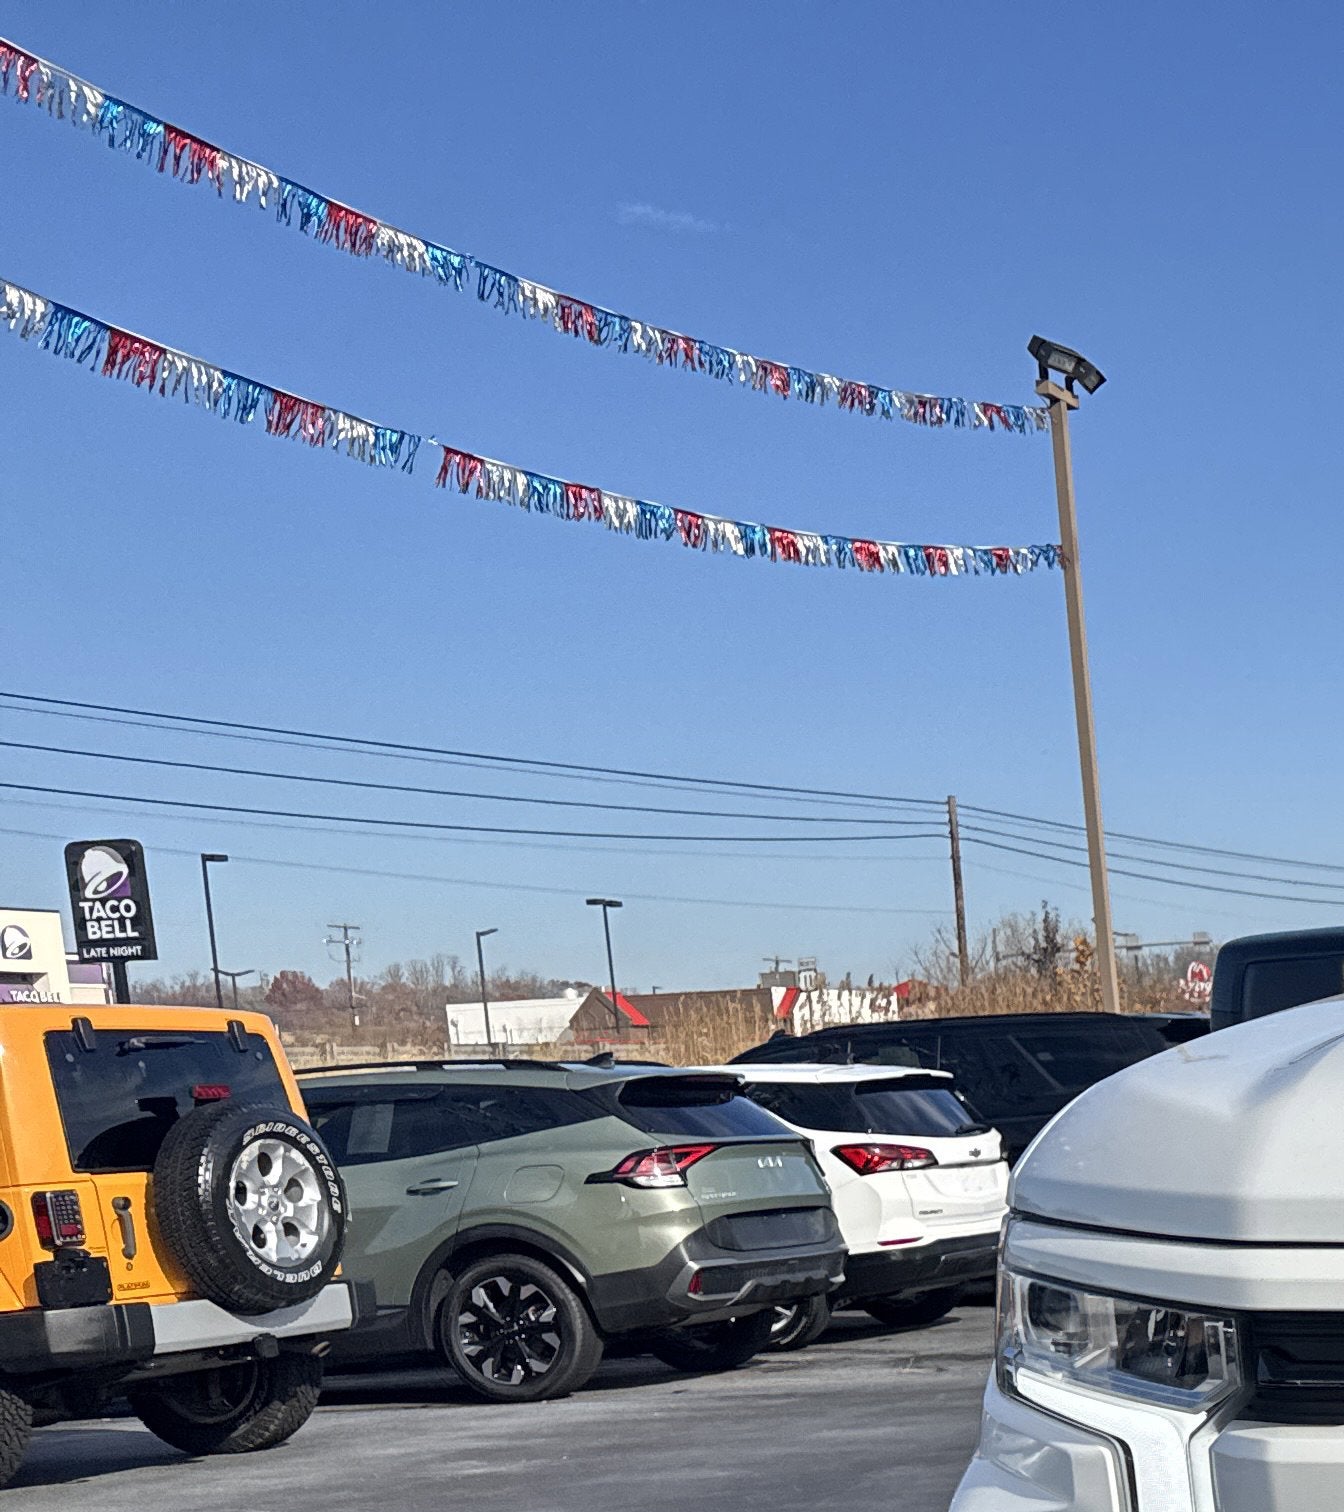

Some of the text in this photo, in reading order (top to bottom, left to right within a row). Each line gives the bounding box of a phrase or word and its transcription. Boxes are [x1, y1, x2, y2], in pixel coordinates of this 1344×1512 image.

[79, 899, 136, 919] TACO
[86, 919, 139, 939] BELL
[83, 946, 142, 958] LATE NIGHT
[10, 990, 40, 1003] TACO
